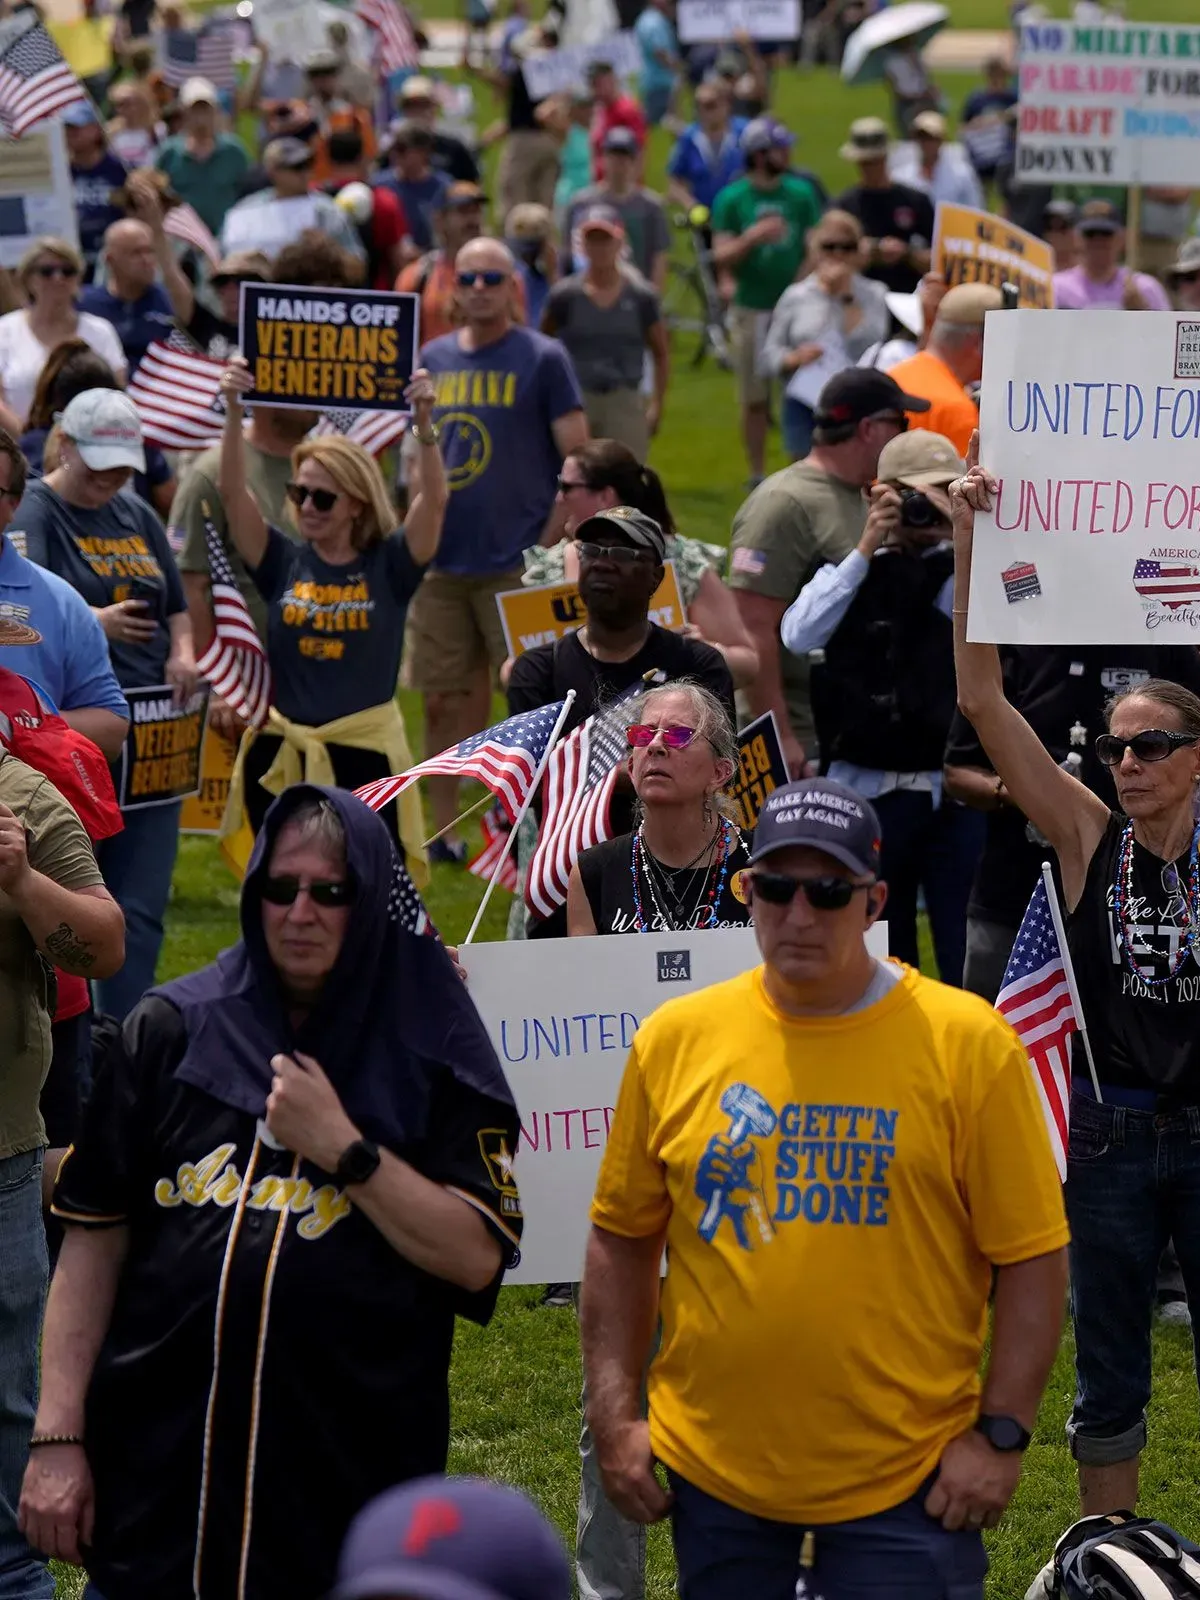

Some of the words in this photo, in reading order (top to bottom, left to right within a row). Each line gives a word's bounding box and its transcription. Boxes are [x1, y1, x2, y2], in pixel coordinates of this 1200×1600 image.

[1025, 25, 1063, 52] NO
[1020, 63, 1140, 95] PARADE
[1020, 105, 1116, 138] DRAFT
[1018, 144, 1117, 174] DONNY
[257, 296, 347, 325] HANDS
[350, 303, 400, 327] OFF
[256, 319, 399, 365] VETERANS
[255, 356, 376, 401] BENEFITS
[1008, 380, 1144, 441] UNITED
[996, 478, 1134, 534] UNITED
[133, 699, 184, 723] HAN
[766, 791, 802, 812] MAKE
[803, 790, 864, 819] AMERICA
[775, 807, 805, 824] GAY
[804, 808, 850, 830] AGAIN
[660, 968, 688, 979] USA
[662, 955, 668, 966] I
[501, 1012, 640, 1063] UNITED
[779, 1103, 898, 1141] GETT'N
[775, 1140, 895, 1183] STUFF
[155, 1142, 350, 1240] Army
[773, 1182, 889, 1226] DONE
[402, 1498, 461, 1557] P
